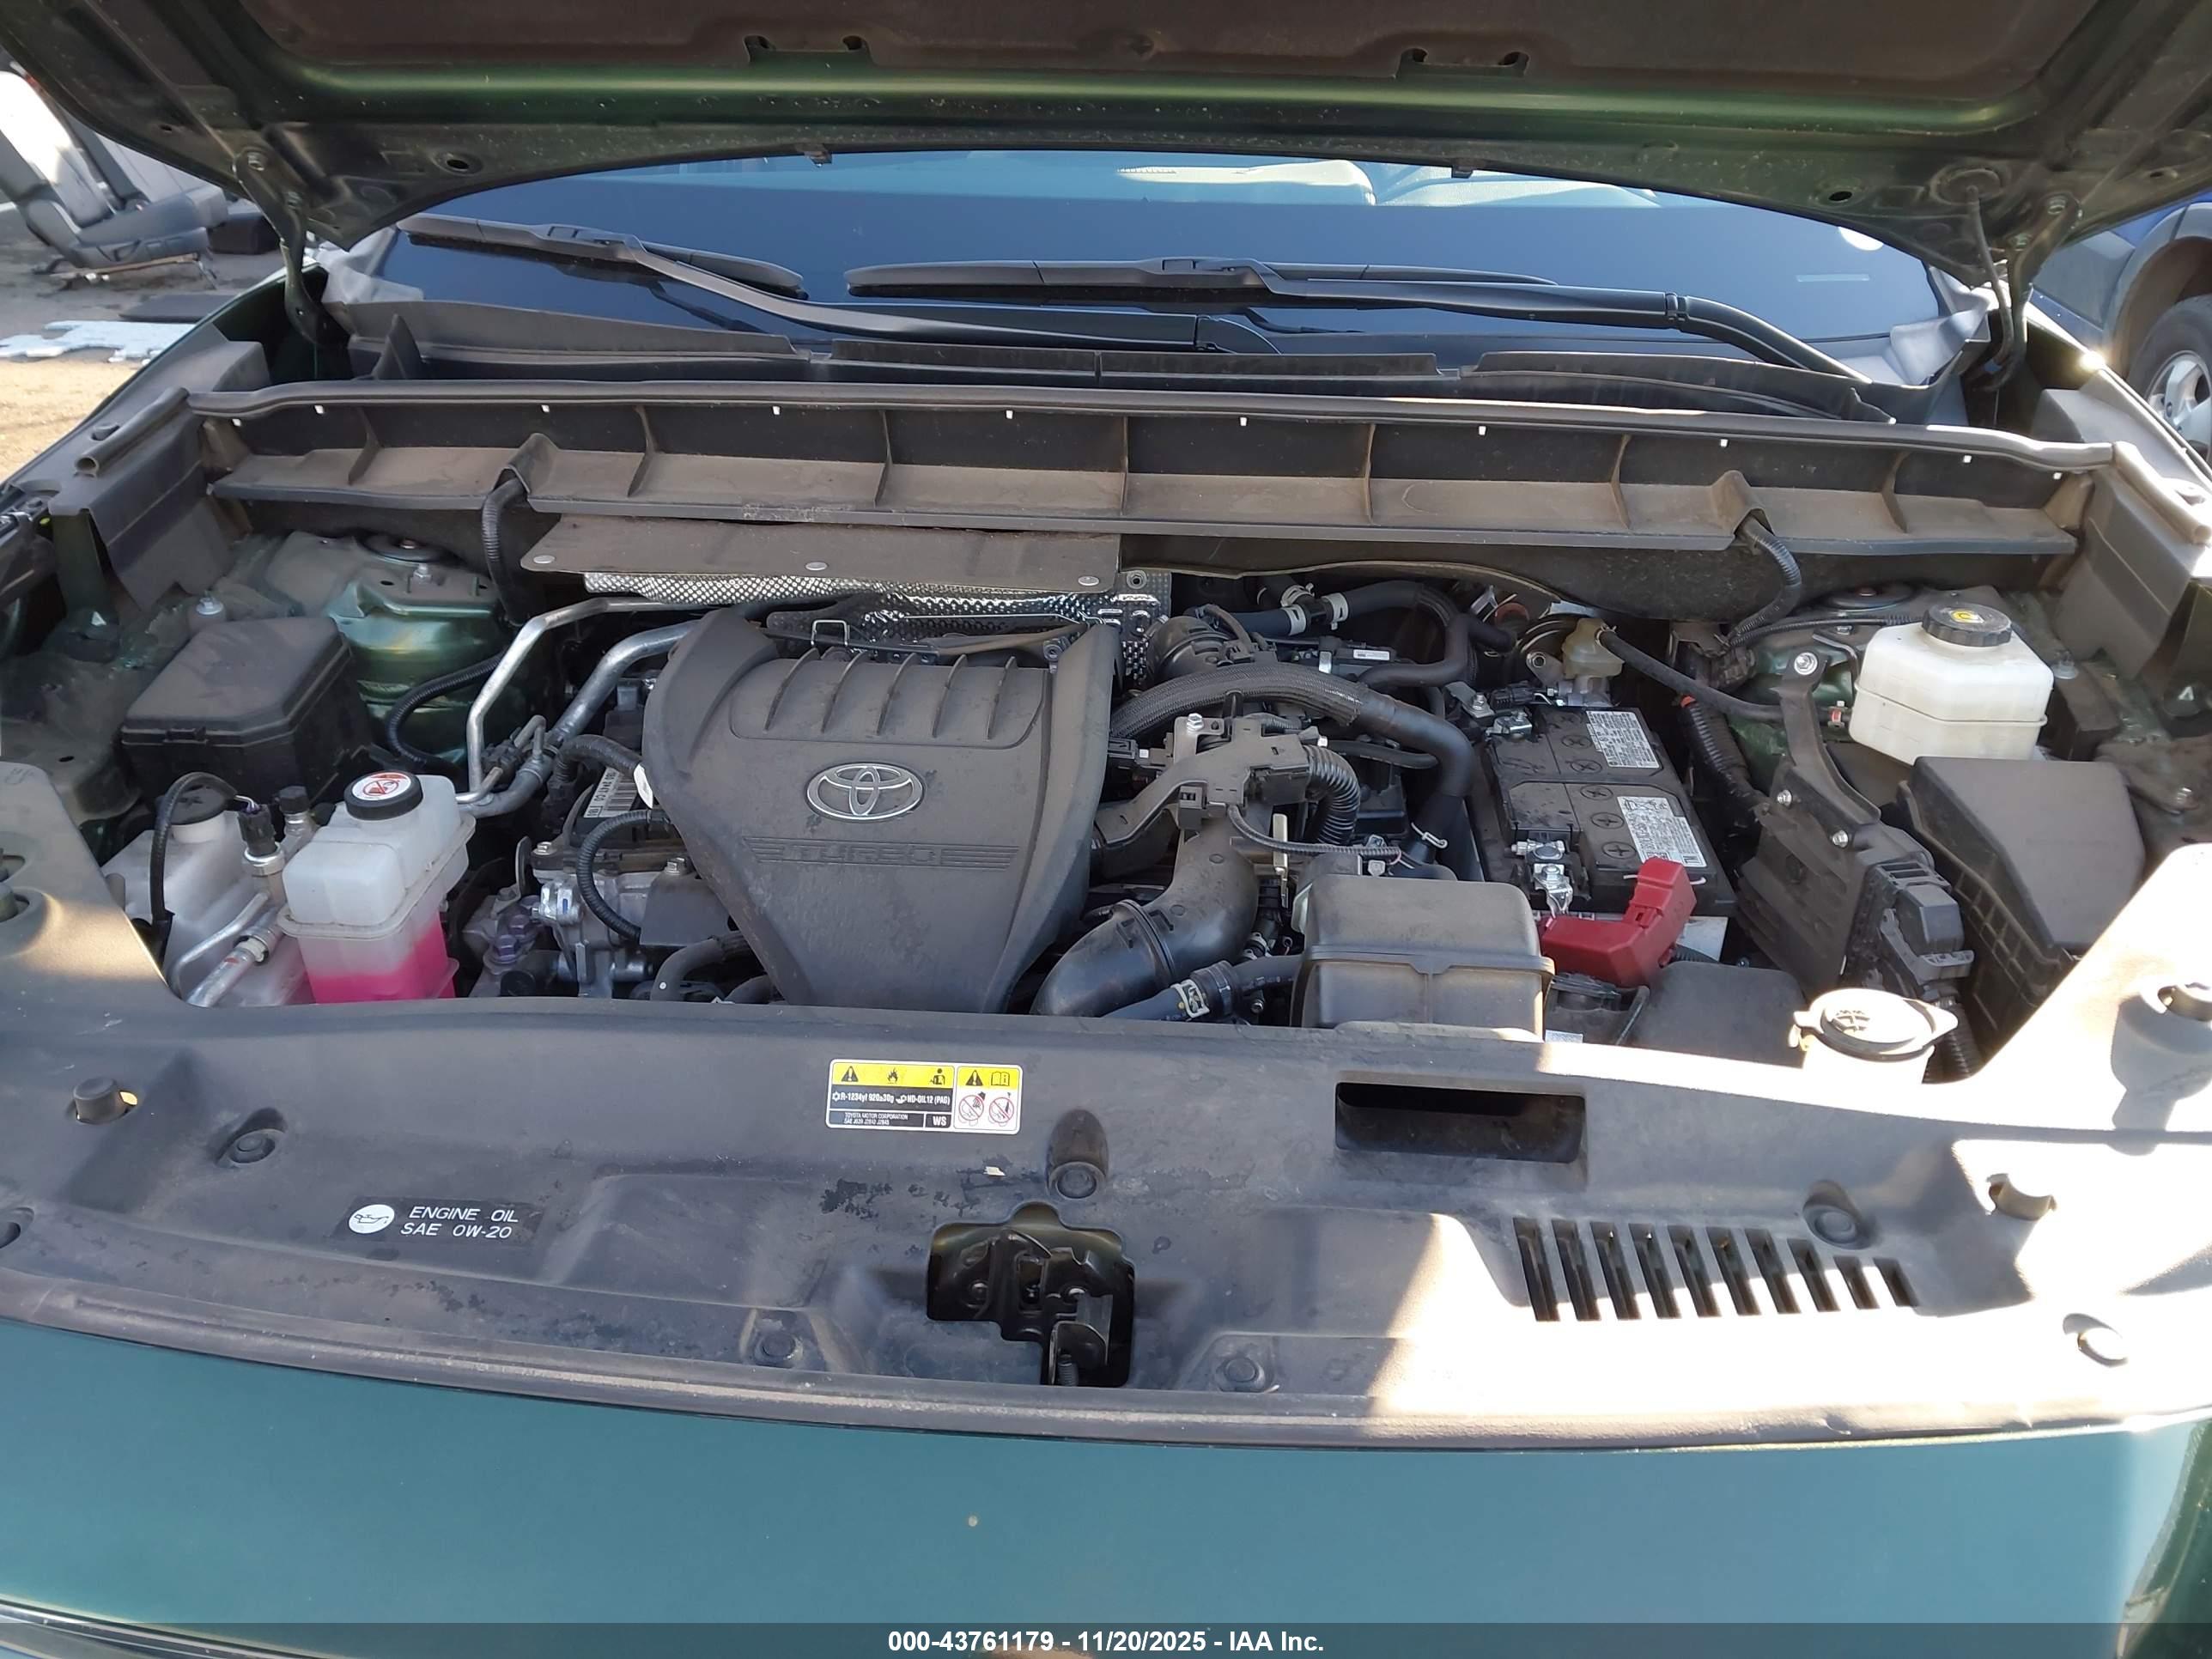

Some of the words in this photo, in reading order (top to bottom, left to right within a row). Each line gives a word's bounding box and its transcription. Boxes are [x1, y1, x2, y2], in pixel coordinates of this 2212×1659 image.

[933, 1115, 947, 1126] WS
[409, 1206, 481, 1220] ENGINE
[490, 1209, 519, 1223] OIL
[400, 1222, 442, 1236] SAE
[453, 1224, 513, 1238] 0W-20
